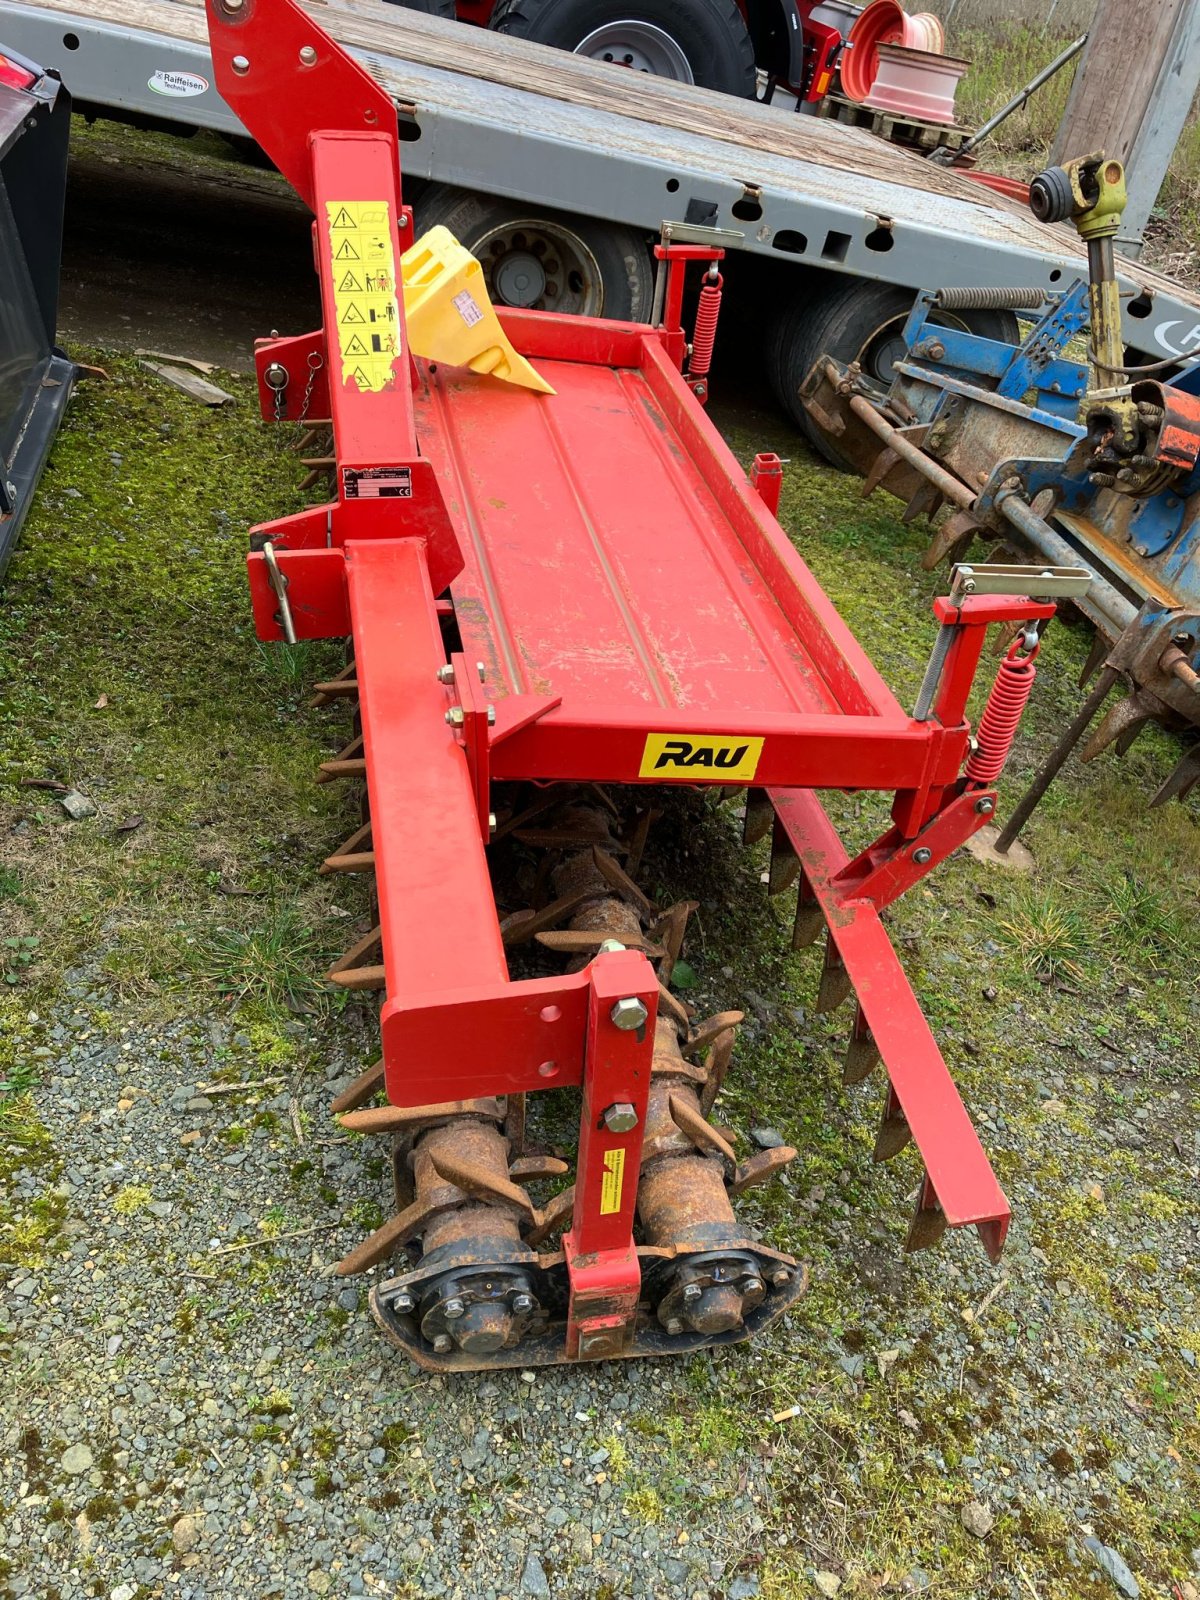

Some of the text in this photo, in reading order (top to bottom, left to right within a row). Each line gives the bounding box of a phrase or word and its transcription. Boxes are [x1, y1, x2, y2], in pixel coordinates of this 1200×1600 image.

[164, 73, 203, 90] Raiffeisen
[164, 81, 186, 92] Technik
[654, 741, 749, 769] RAU
